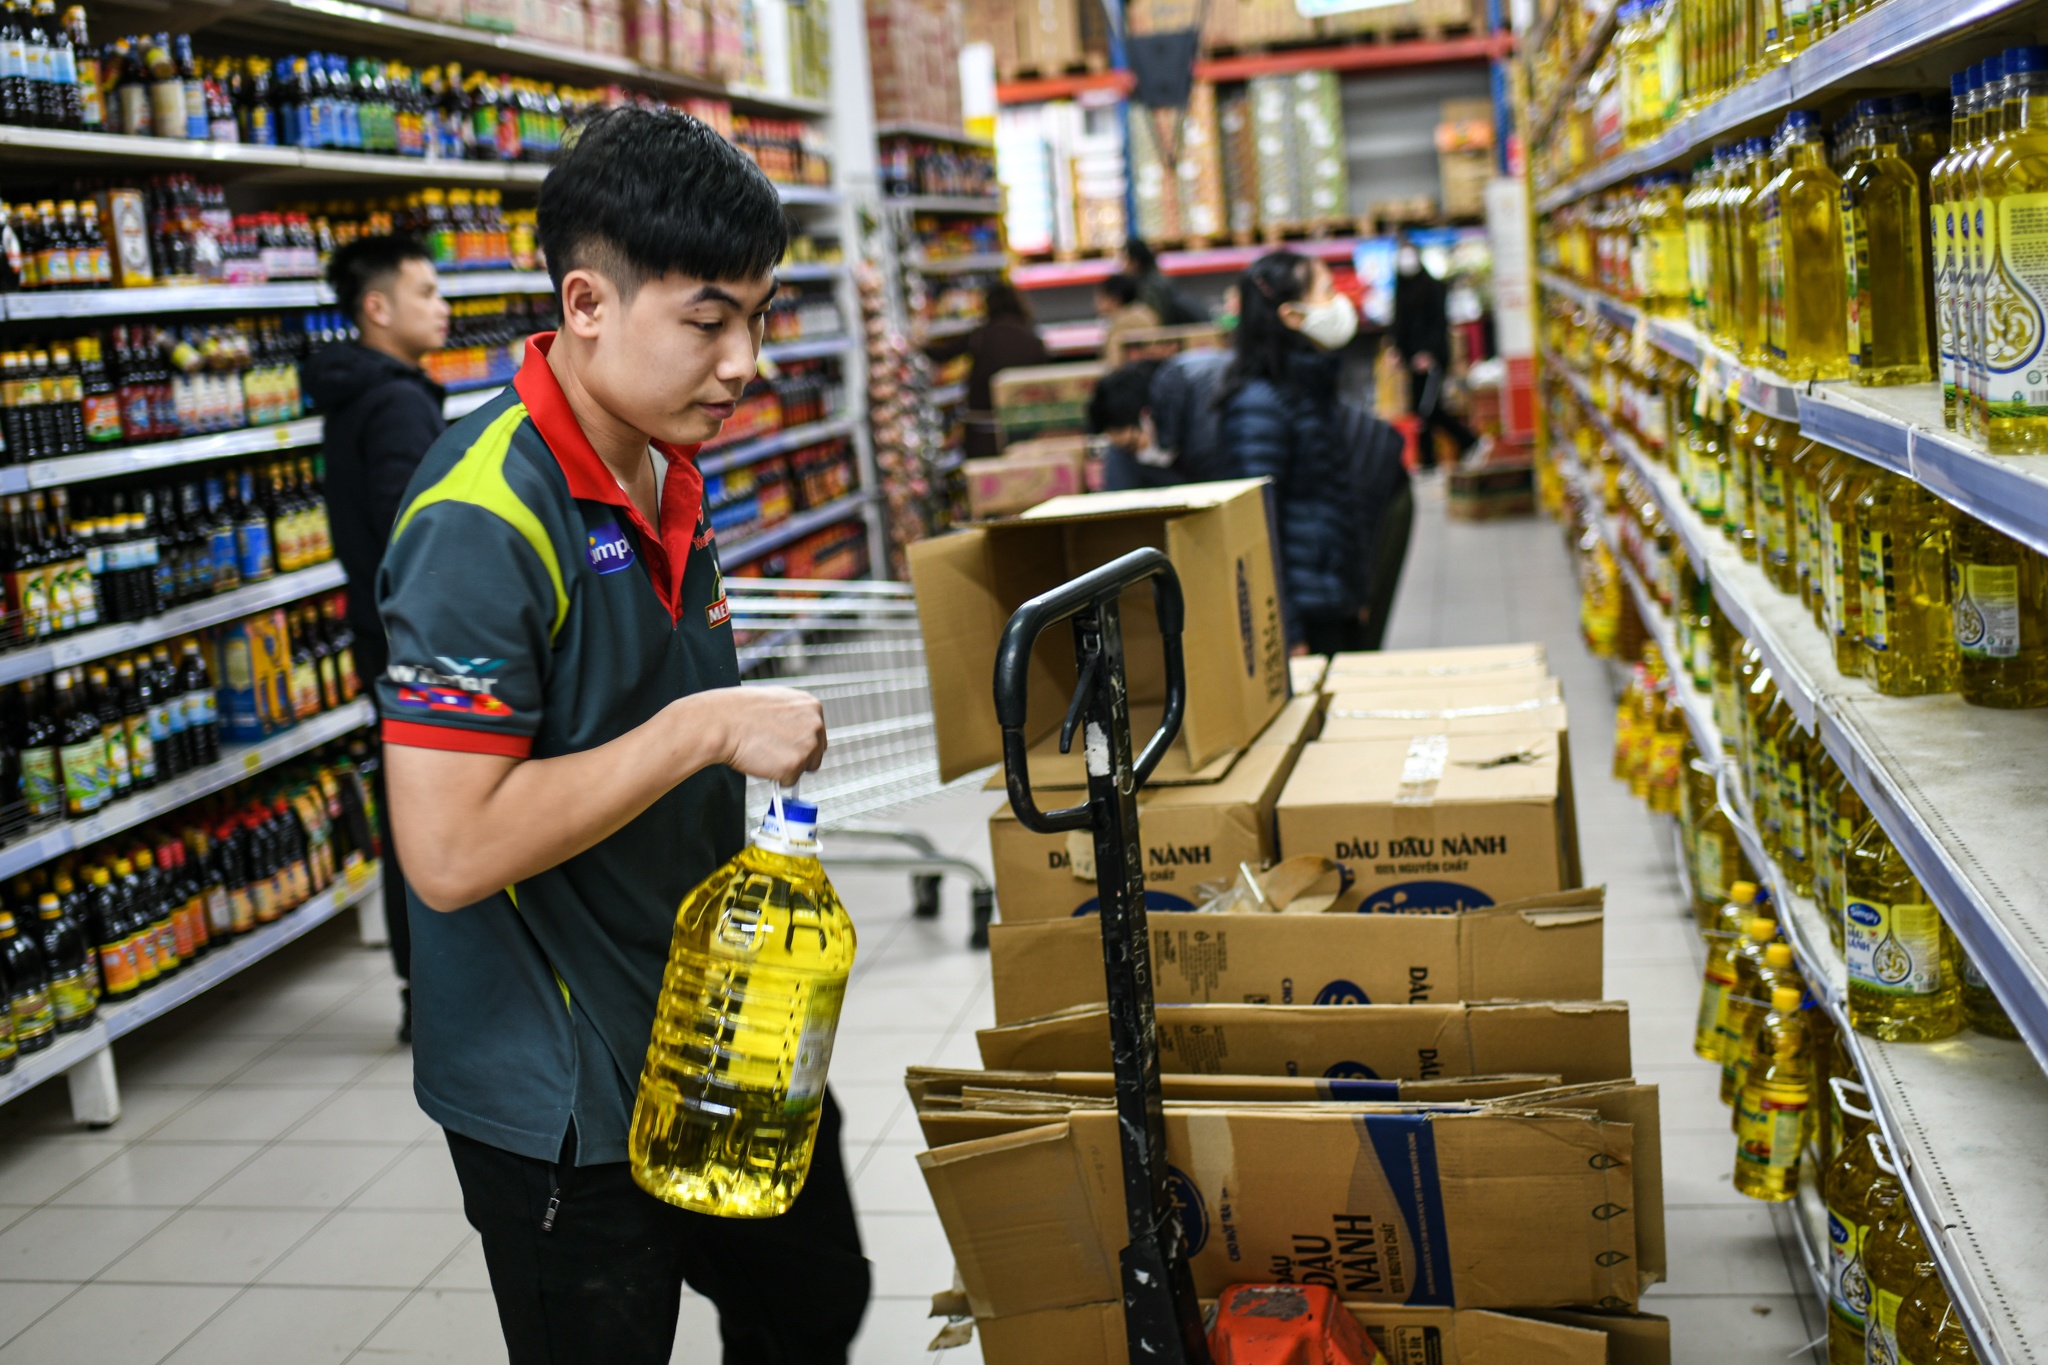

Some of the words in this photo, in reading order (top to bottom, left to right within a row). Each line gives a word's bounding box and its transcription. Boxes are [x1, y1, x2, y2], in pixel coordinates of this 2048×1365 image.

[1150, 842, 1211, 866] NÀNH
[1442, 832, 1506, 856] NÀNH
[1333, 1214, 1383, 1293] NÀNH
